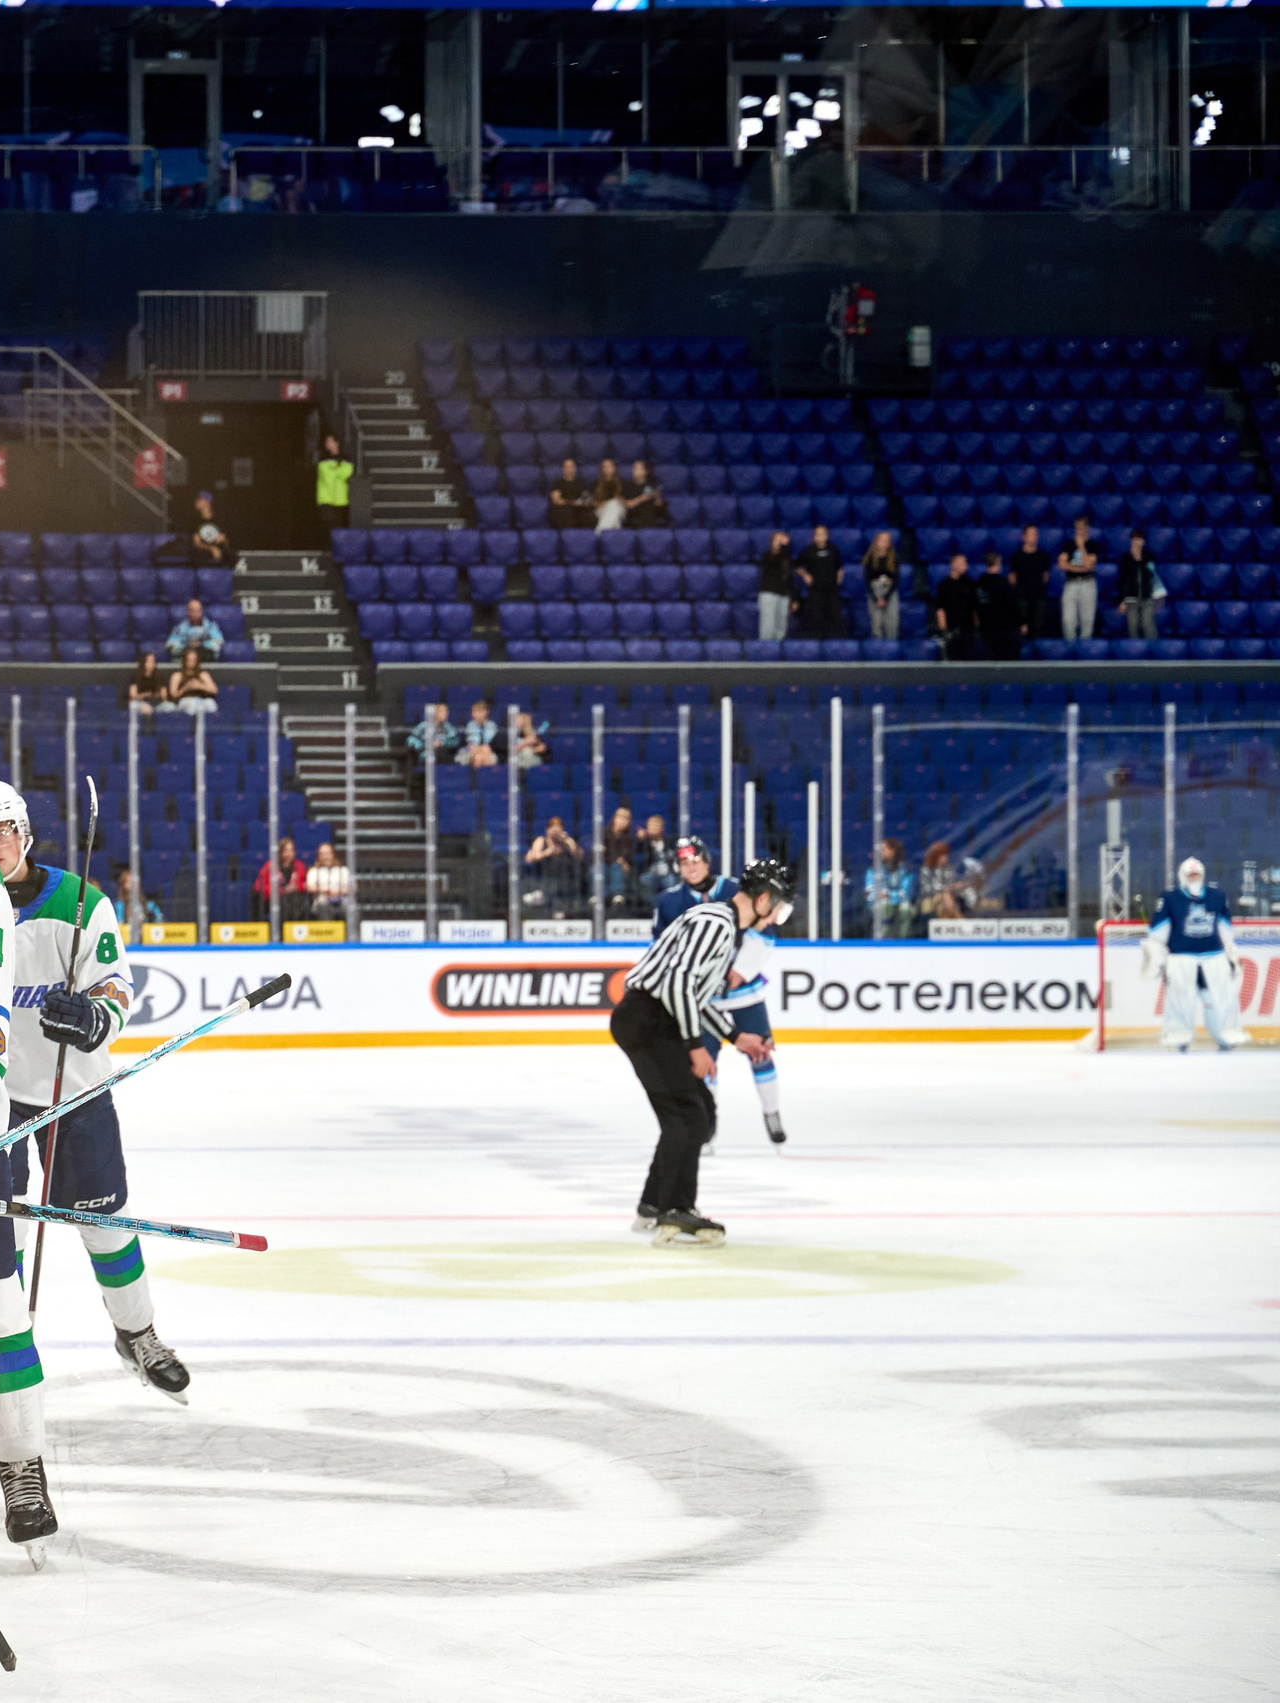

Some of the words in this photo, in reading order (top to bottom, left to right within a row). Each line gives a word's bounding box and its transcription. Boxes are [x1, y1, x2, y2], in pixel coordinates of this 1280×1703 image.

[95, 931, 119, 965] 8
[445, 971, 606, 1007] WINLINE
[782, 970, 1112, 1013] Ростелеком
[73, 1192, 117, 1210] CCM
[73, 1211, 150, 1231] JETSPEED
